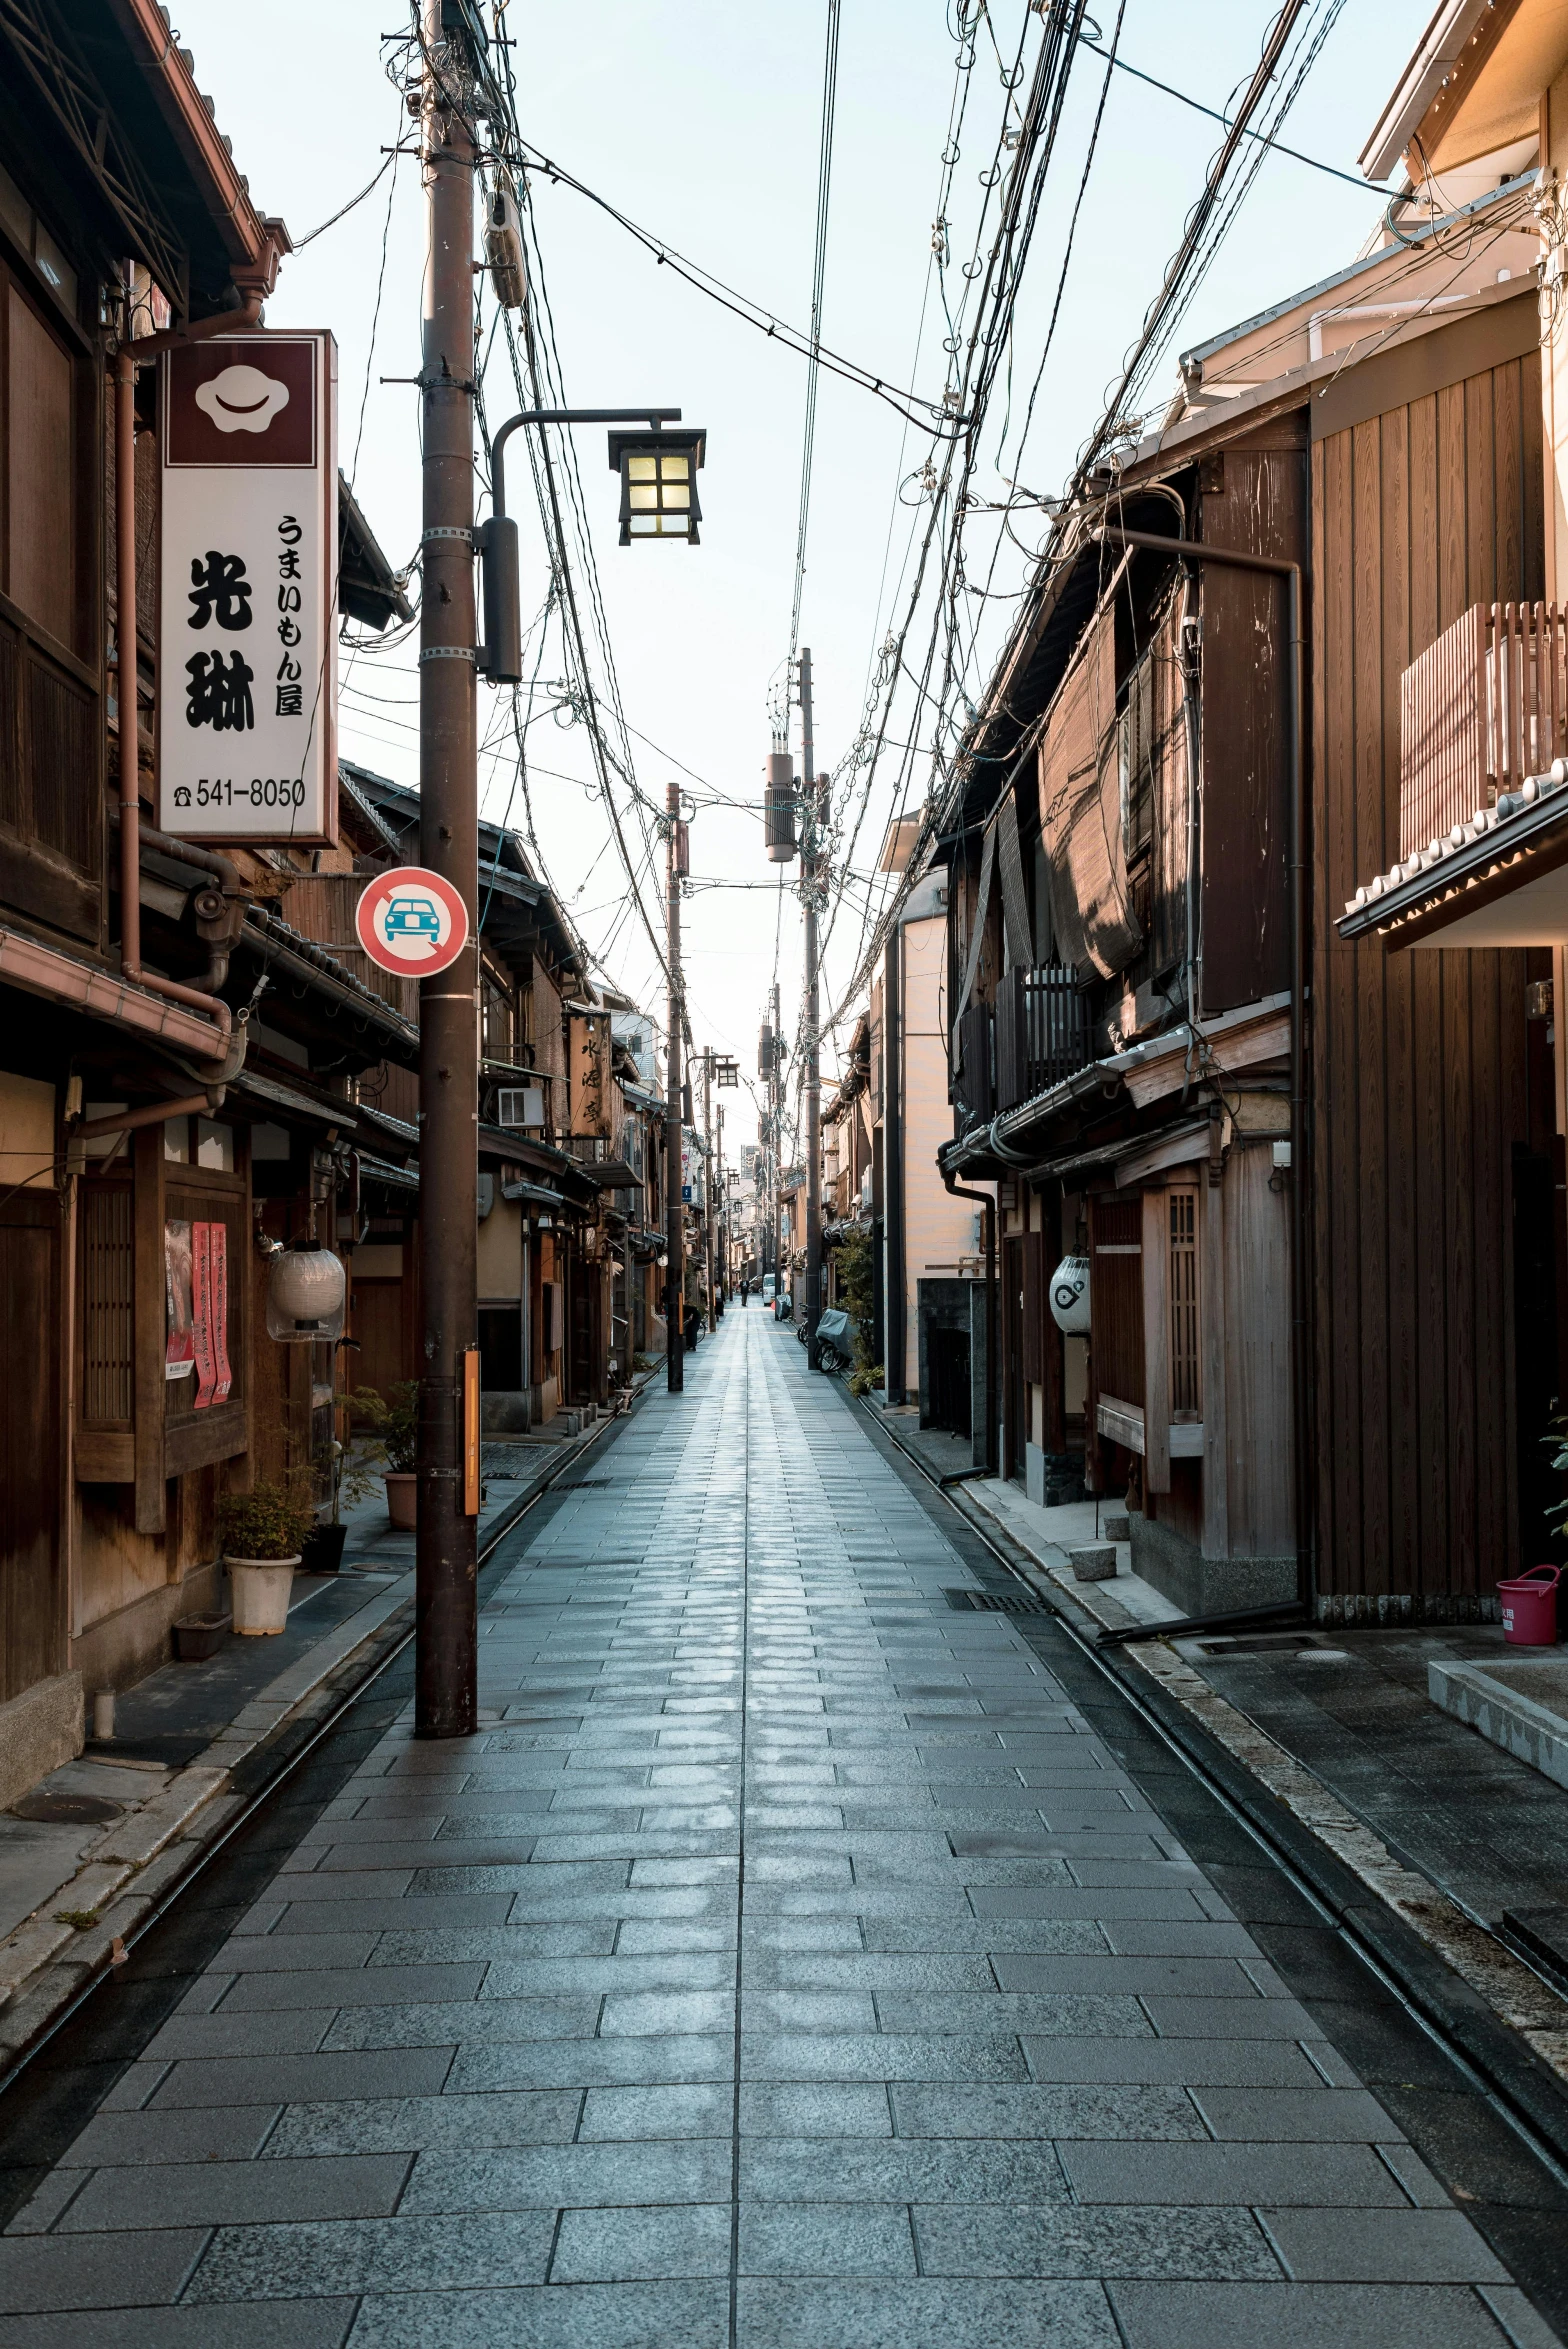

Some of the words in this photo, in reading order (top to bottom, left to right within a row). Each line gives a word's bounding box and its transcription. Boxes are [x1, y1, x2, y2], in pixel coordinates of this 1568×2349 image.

[185, 551, 254, 731] 光琳
[276, 516, 302, 716] うまいもん屋
[197, 779, 305, 807] 541-8050
